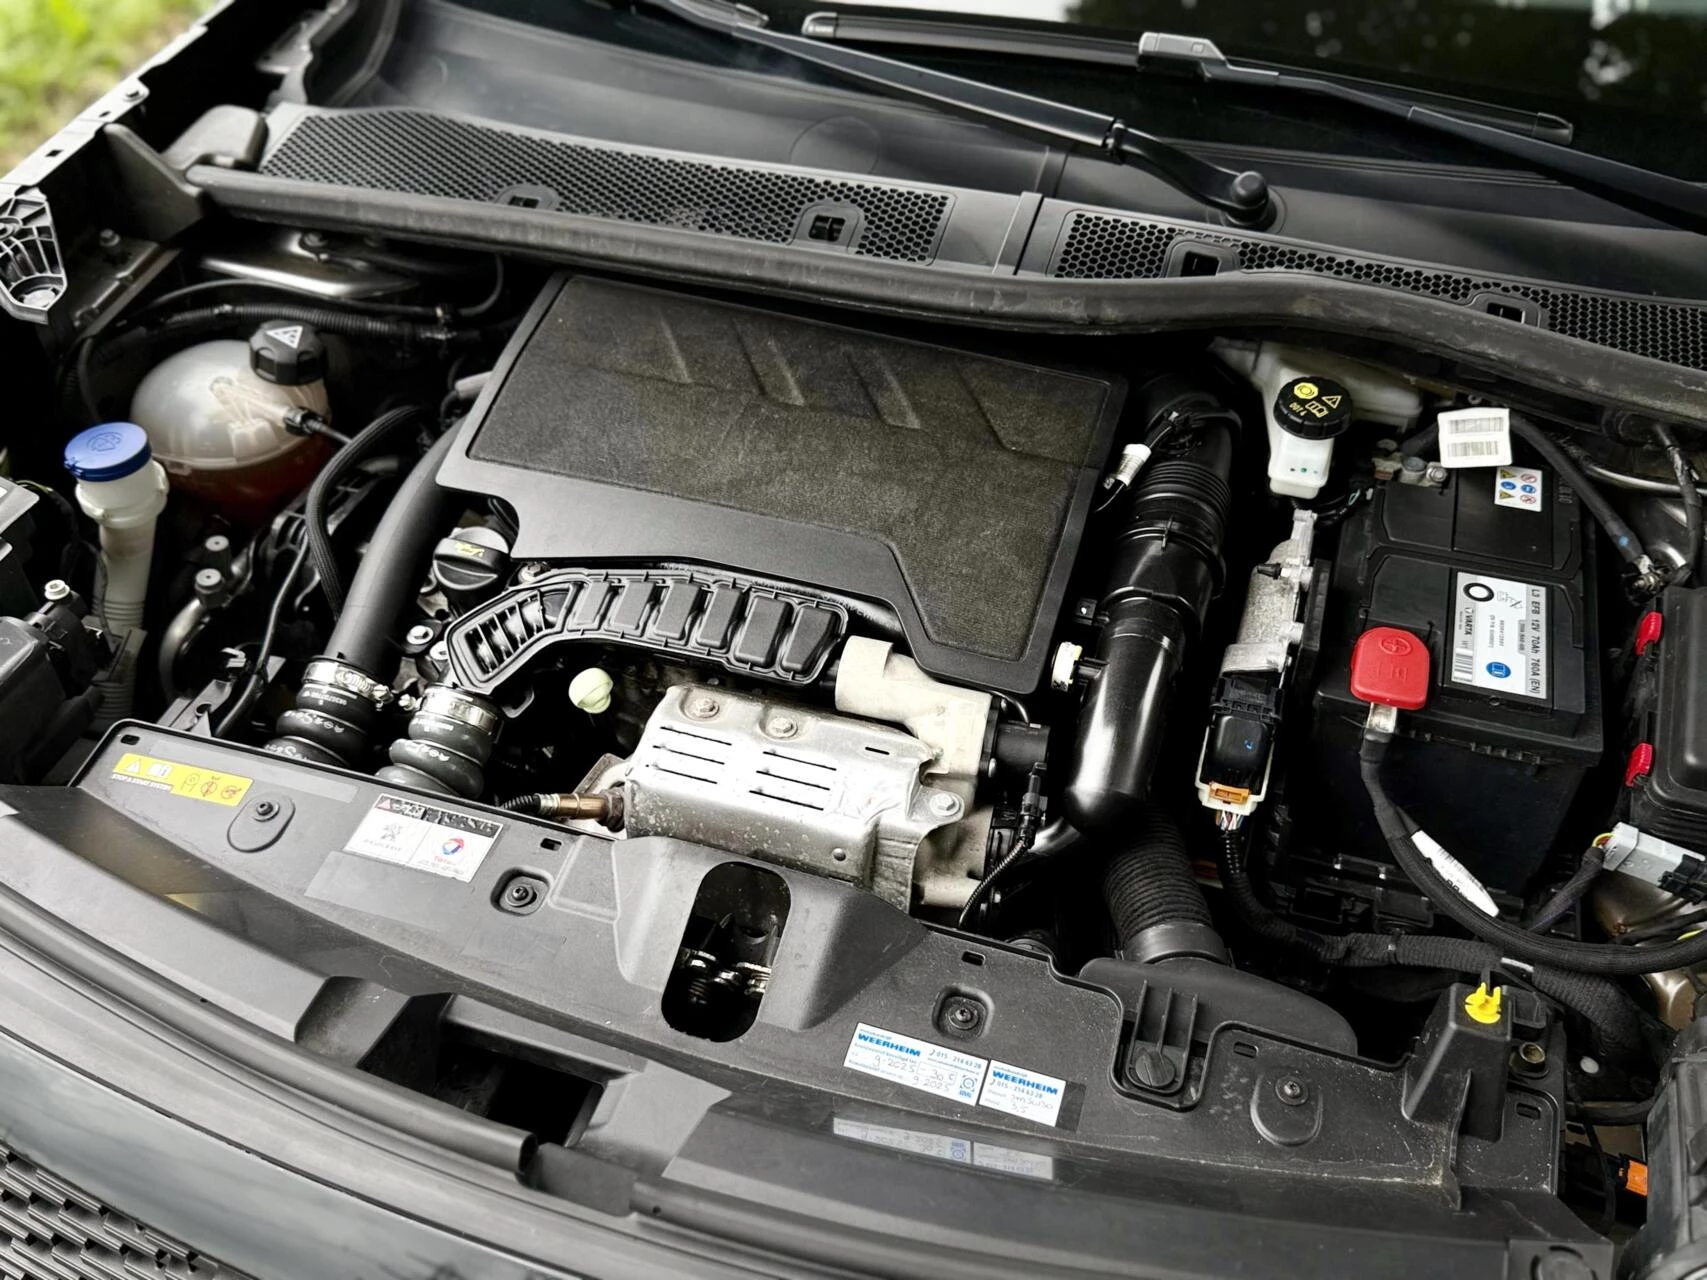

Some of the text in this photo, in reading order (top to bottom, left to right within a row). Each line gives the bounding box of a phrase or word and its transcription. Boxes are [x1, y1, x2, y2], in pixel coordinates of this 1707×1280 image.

[1463, 613, 1473, 635] VARTA
[1528, 588, 1540, 694] L3 EFB 12V 70Ah 760A (EN)
[858, 1033, 920, 1057] WEERHEIM
[992, 1070, 1058, 1095] WEERHEIM
